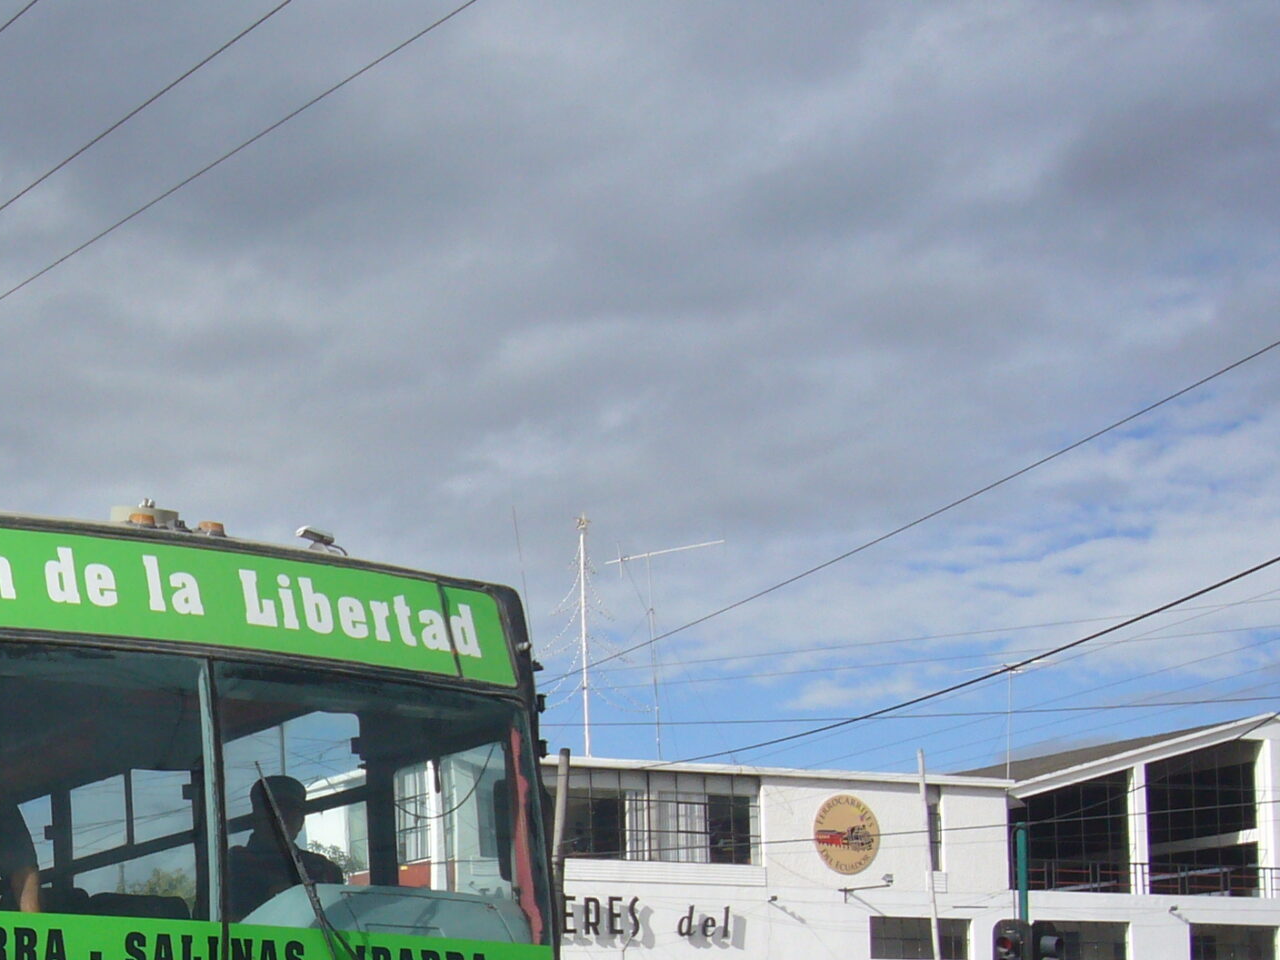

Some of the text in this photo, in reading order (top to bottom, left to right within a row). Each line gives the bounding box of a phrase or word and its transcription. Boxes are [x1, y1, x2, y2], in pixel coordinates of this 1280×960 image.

[44, 546, 118, 607] de
[142, 554, 205, 616] la
[238, 568, 482, 658] Libertad
[678, 905, 730, 938] del
